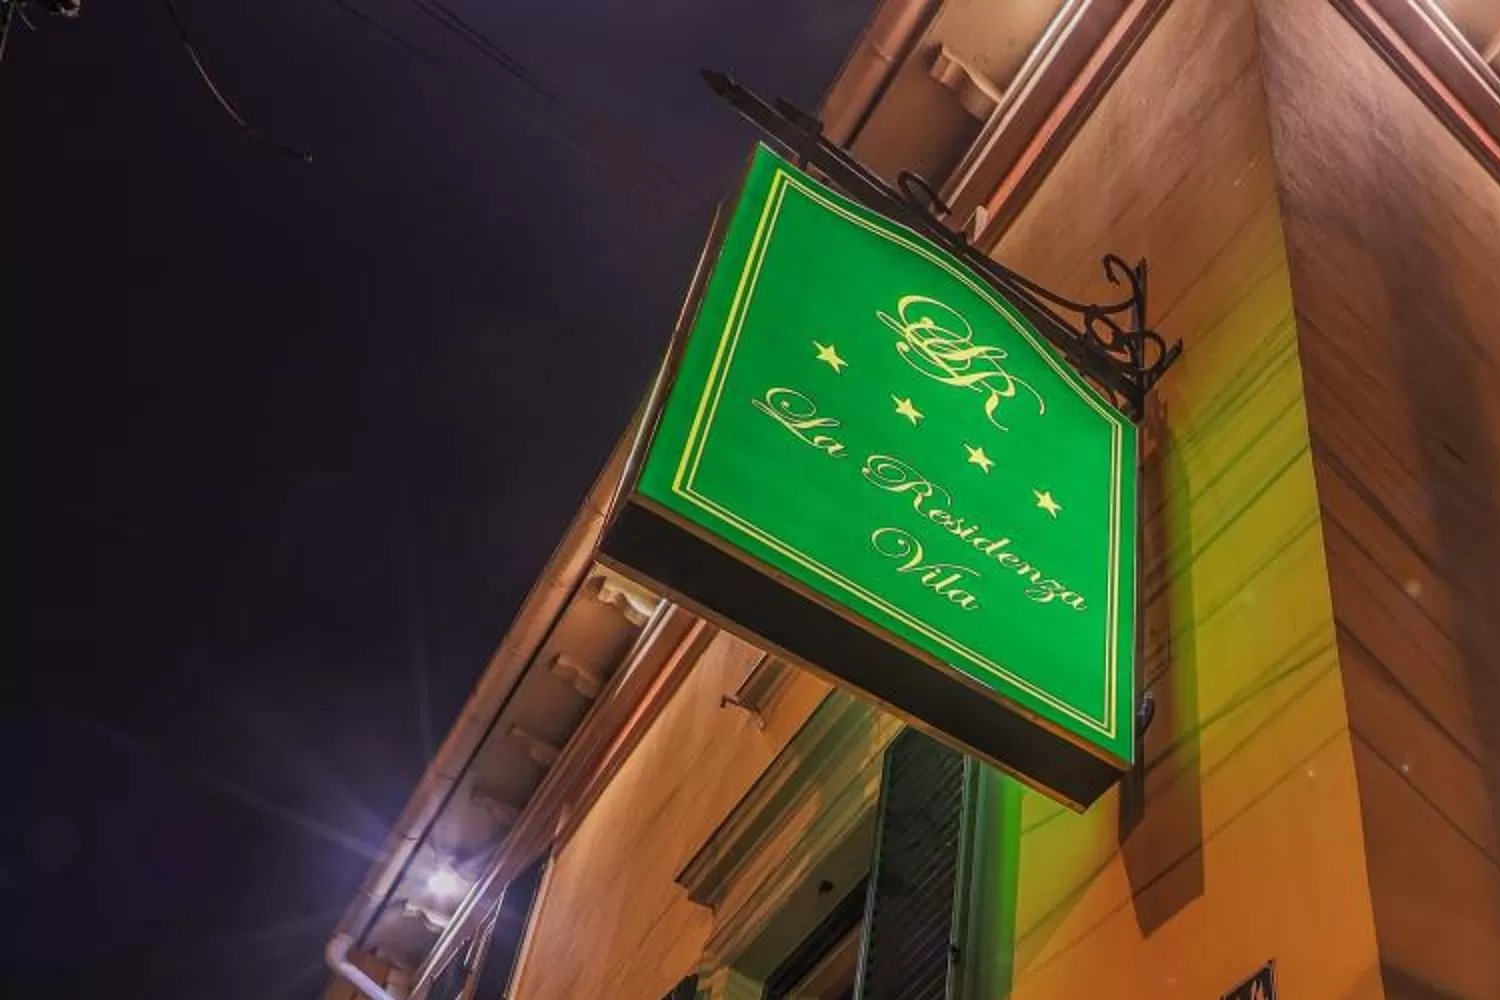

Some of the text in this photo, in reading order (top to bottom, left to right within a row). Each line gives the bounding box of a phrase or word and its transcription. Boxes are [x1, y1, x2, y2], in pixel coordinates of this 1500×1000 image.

[752, 387, 1088, 611] La Residenza
[871, 527, 981, 611] Vila
